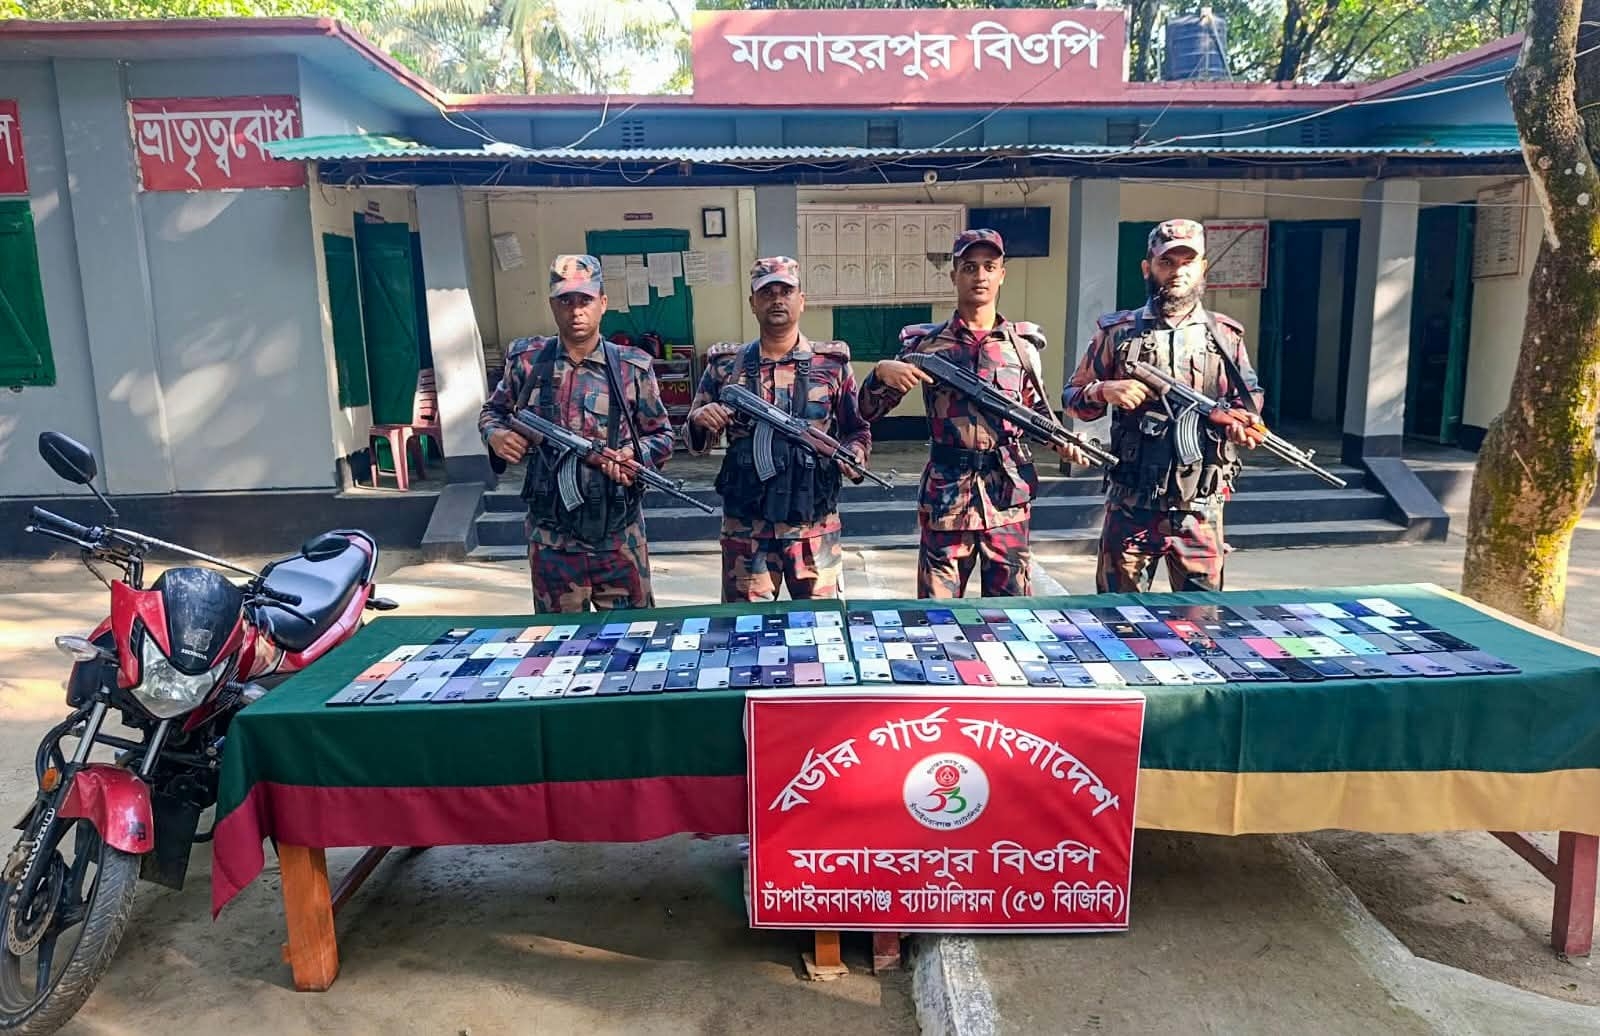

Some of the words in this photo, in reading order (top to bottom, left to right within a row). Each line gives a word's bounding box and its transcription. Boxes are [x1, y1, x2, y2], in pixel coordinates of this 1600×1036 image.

[724, 31, 957, 80] মনোহরপুর
[966, 20, 1105, 70] বিওপি
[134, 103, 297, 187] ভ্রাতৃত্ববোধ
[181, 648, 208, 661] HONDA
[768, 739, 861, 811] বর্ডার
[868, 706, 951, 751] গার্ড
[957, 717, 1119, 817] বাংলাদেশ
[787, 847, 979, 880] মনোহরপুর
[988, 840, 1101, 874] বিওপি
[761, 881, 892, 912] চাঁপাইনবাবগঞ্জ
[898, 882, 996, 913] ব্যাটালিয়ন
[1002, 885, 1045, 918] (৫৩
[1052, 880, 1126, 918] বিজিবি)
